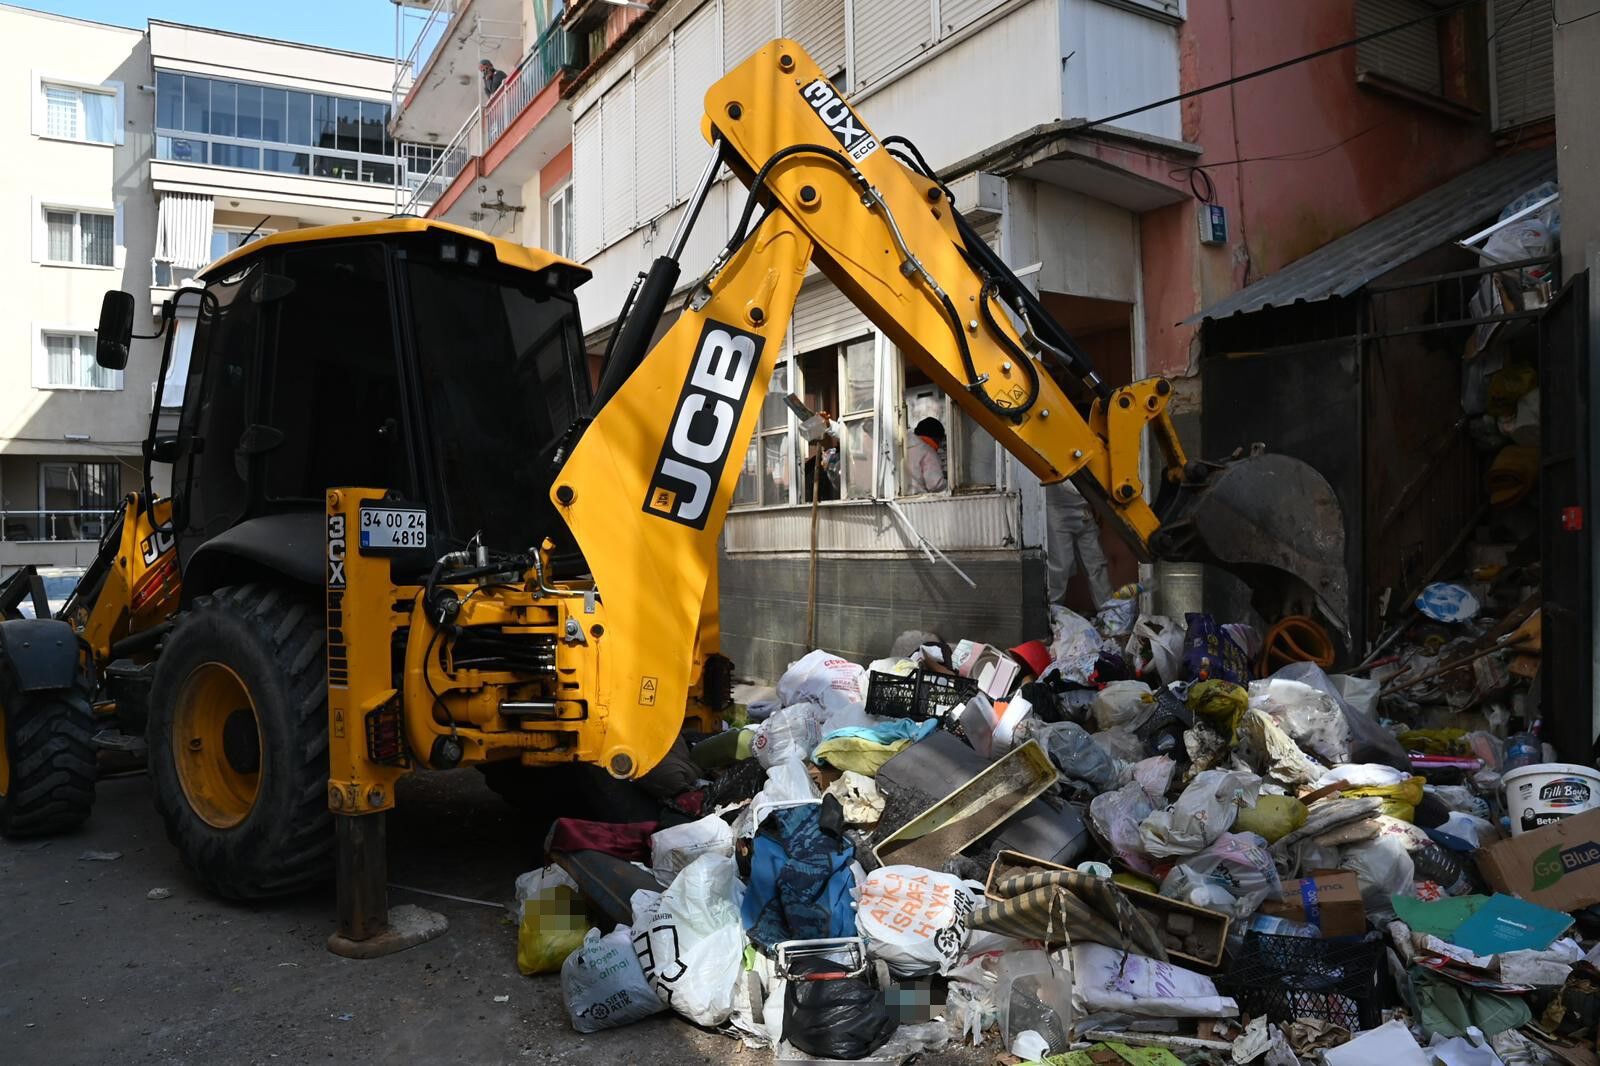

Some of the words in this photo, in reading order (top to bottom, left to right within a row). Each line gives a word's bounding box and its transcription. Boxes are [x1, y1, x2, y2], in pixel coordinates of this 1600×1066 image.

[804, 80, 866, 147] 3CX
[853, 140, 876, 159] ECO
[661, 329, 755, 520] JCB
[363, 512, 381, 527] 34
[386, 513, 402, 528] 00
[408, 514, 424, 528] 24
[391, 530, 425, 545] 4819
[144, 521, 175, 565] JC
[328, 516, 346, 584] 3CX
